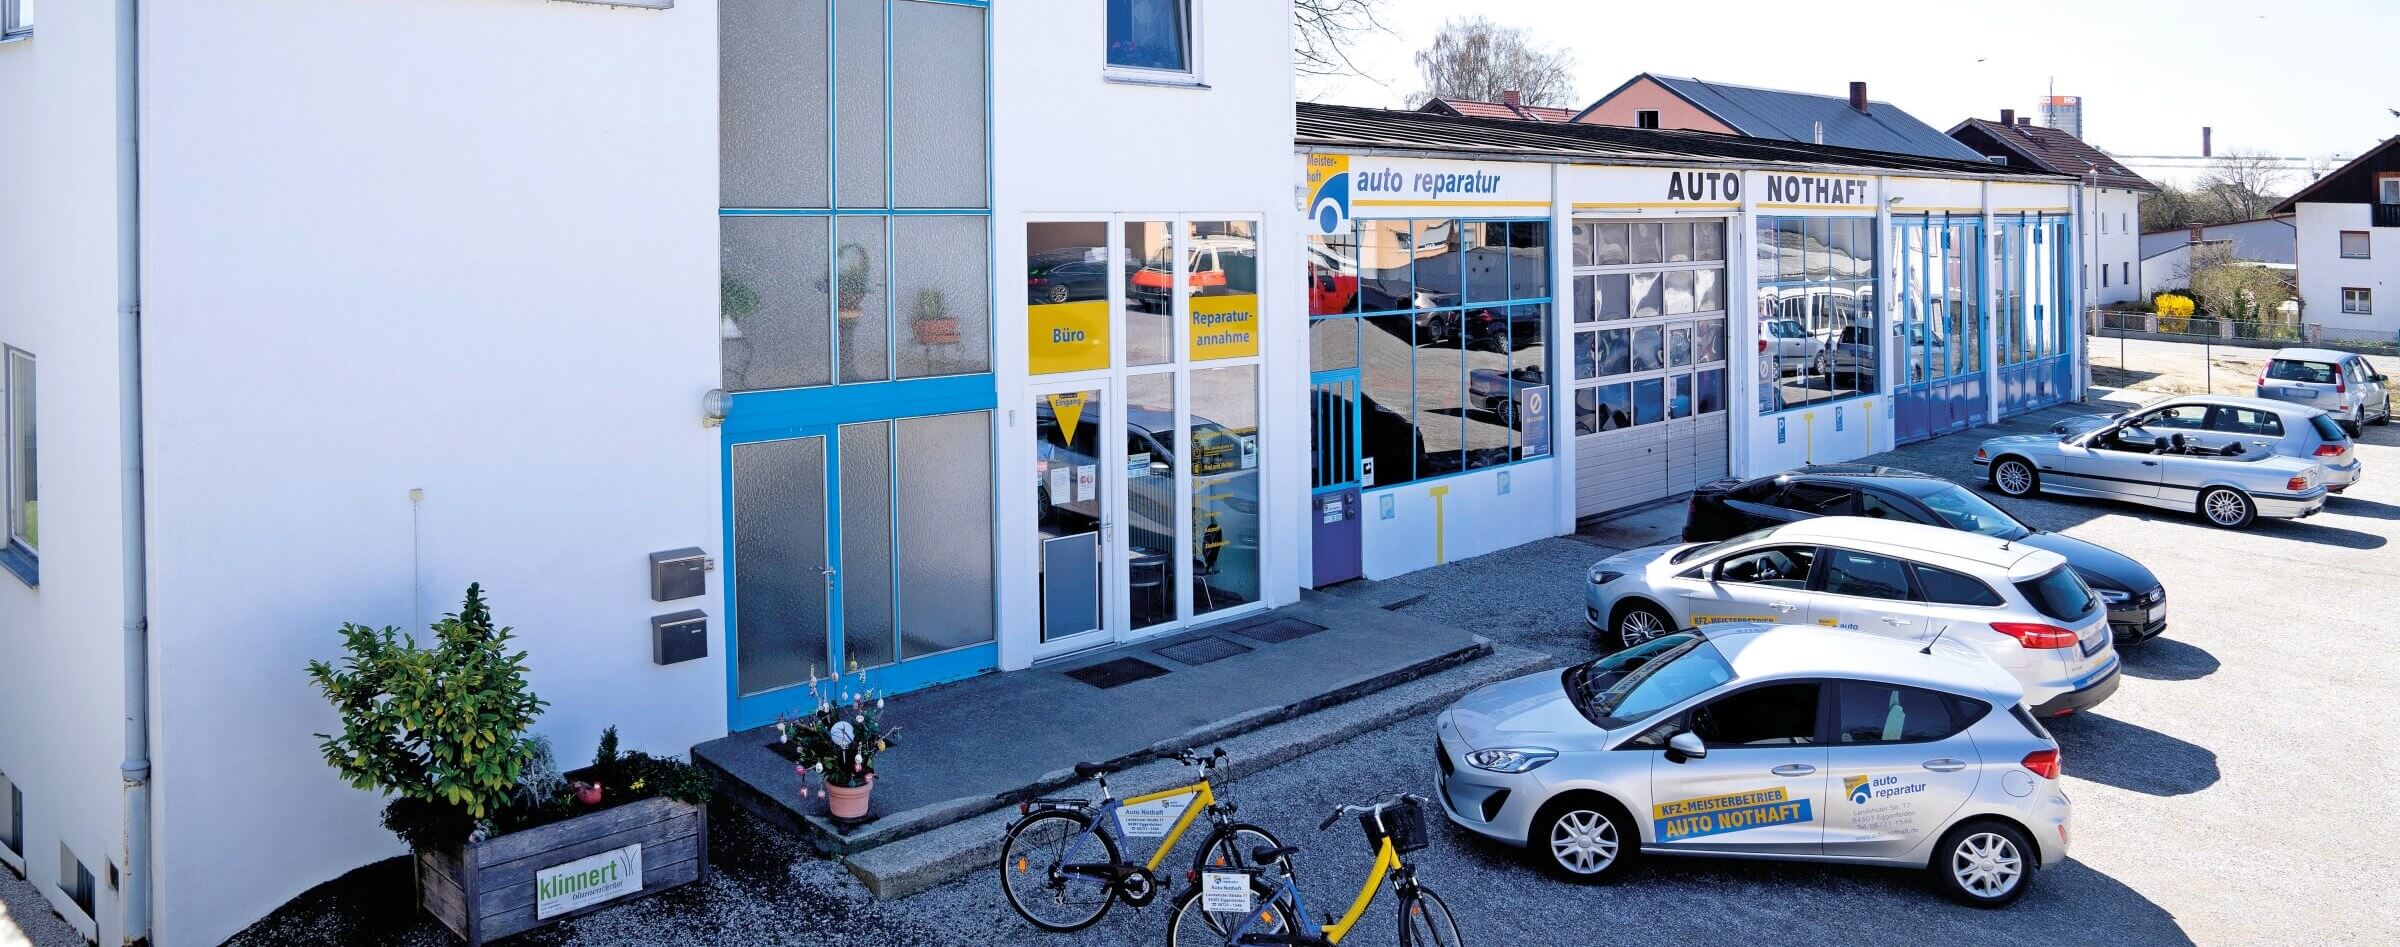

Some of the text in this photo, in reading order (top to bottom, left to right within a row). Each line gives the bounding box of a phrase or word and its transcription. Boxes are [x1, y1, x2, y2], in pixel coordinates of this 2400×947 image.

[1306, 171, 1322, 183] haft
[1357, 167, 1501, 199] auto reparatur
[1667, 171, 1868, 204] AUTO NOTHAFT
[1192, 310, 1253, 327] Reparatur-
[1052, 328, 1085, 343] Büro
[1196, 330, 1250, 347] annahme
[1055, 398, 1080, 407] Eingang
[1873, 775, 1898, 787] auto
[1875, 783, 1926, 798] reparatur
[1661, 790, 1783, 816] KFZ-MEISTERBETRIEB
[1666, 803, 1801, 838] AUTO NOTHAFT
[540, 860, 618, 901] klinnert
